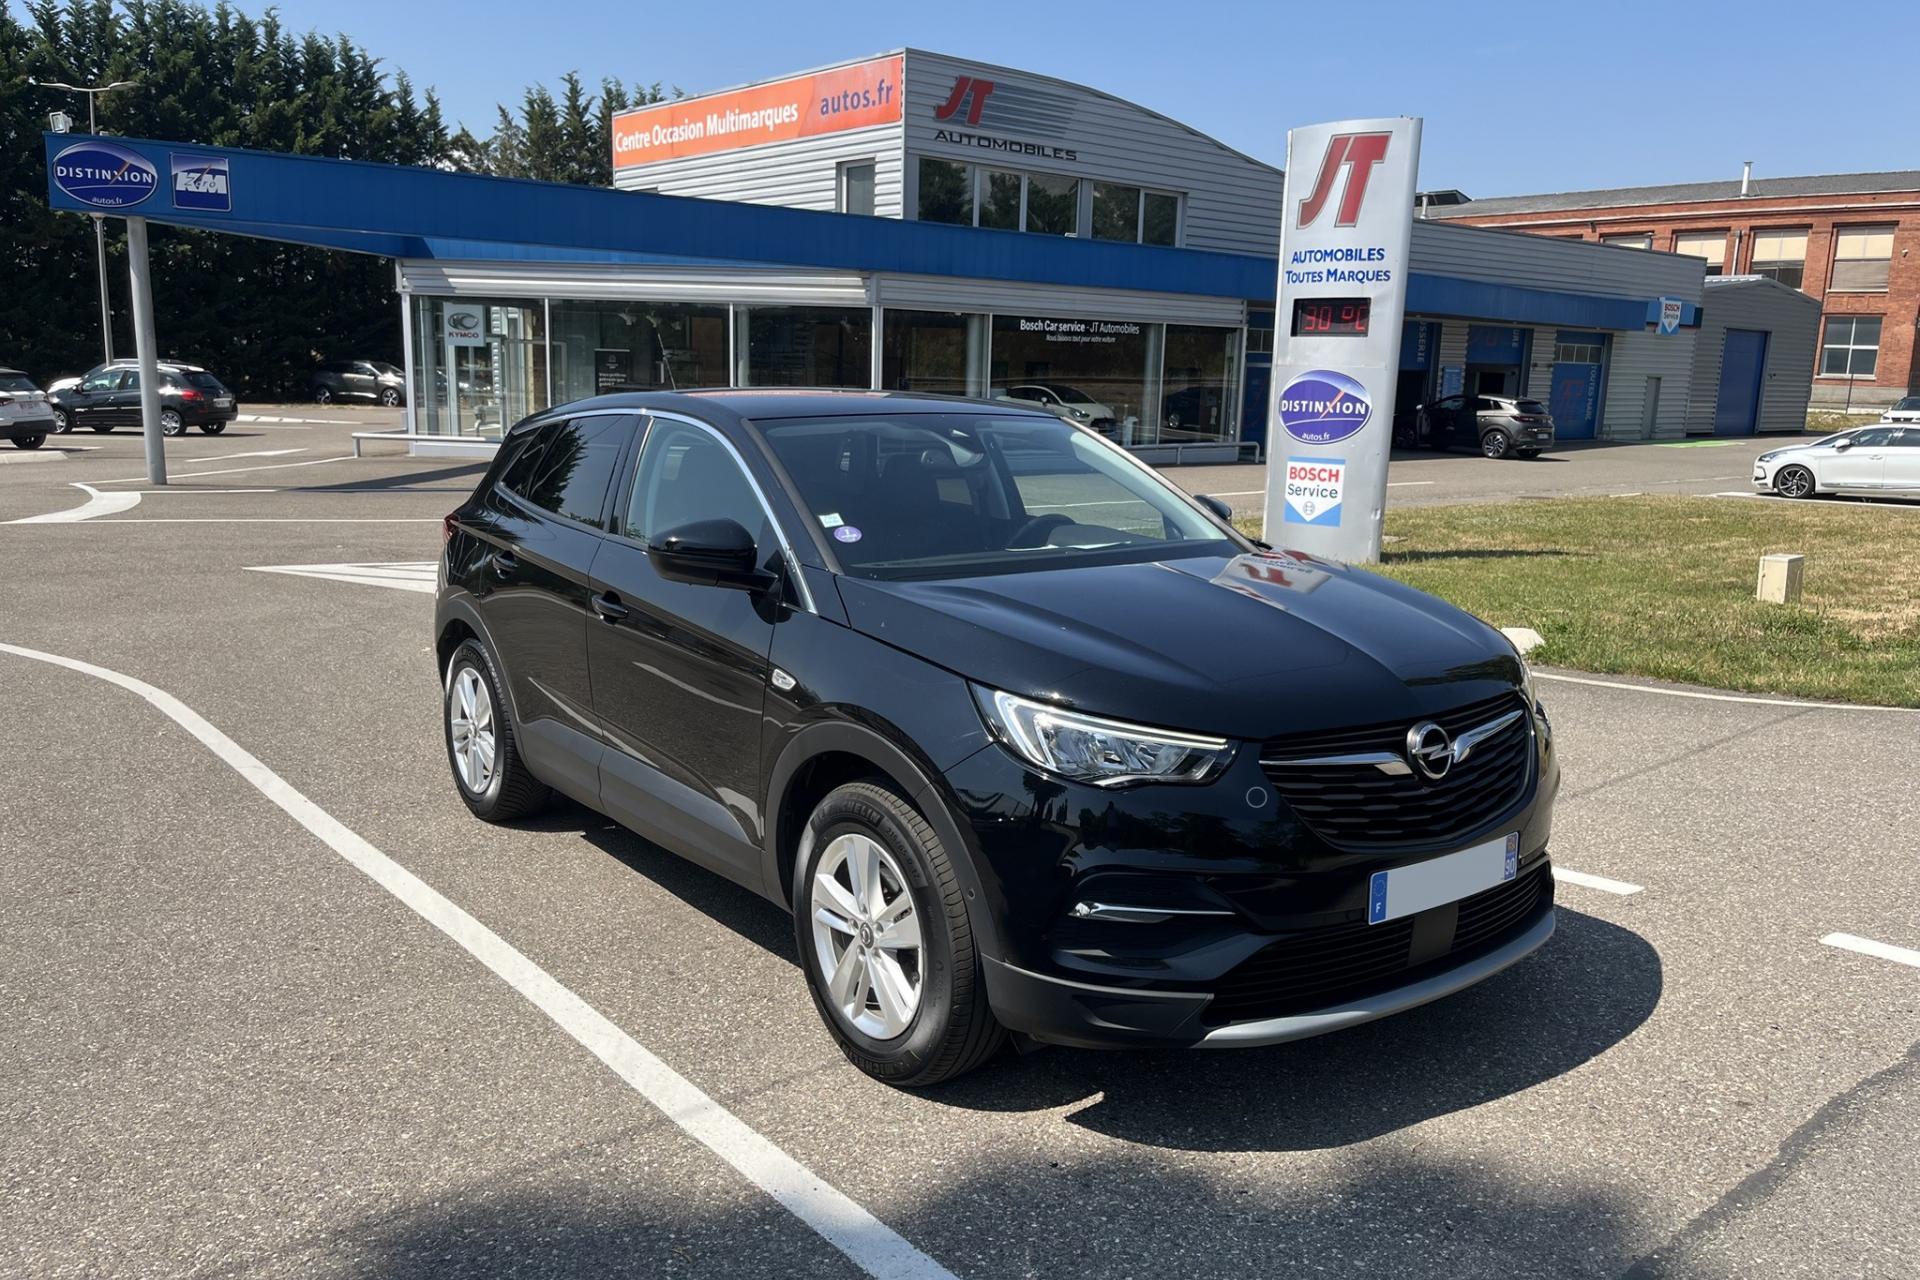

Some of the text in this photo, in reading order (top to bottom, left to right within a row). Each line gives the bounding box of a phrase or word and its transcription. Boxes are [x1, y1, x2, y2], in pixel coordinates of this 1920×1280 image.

[934, 75, 995, 127] JT
[615, 79, 893, 152] Centre Occasion Multimarques autos.fr
[934, 130, 1077, 161] AUTOMOBILES
[57, 166, 152, 183] DISTINXION
[1296, 131, 1392, 229] JT
[91, 196, 123, 205] autos.fr
[1291, 248, 1385, 264] AUTOMOBILES
[1286, 268, 1391, 284] TOUTES MARQUES
[1304, 306, 1332, 330] 30
[1020, 319, 1043, 331] Bosch
[1044, 320, 1058, 331] Car
[1058, 321, 1086, 332] service
[1090, 322, 1099, 332] JT
[1099, 322, 1140, 334] Automobiles
[448, 331, 479, 339] KYMCO
[1281, 400, 1366, 415] DISTINXION
[1302, 432, 1330, 440] autos.fr
[1289, 467, 1340, 482] BOSCH
[1287, 483, 1338, 499] Service
[1375, 902, 1382, 913] F
